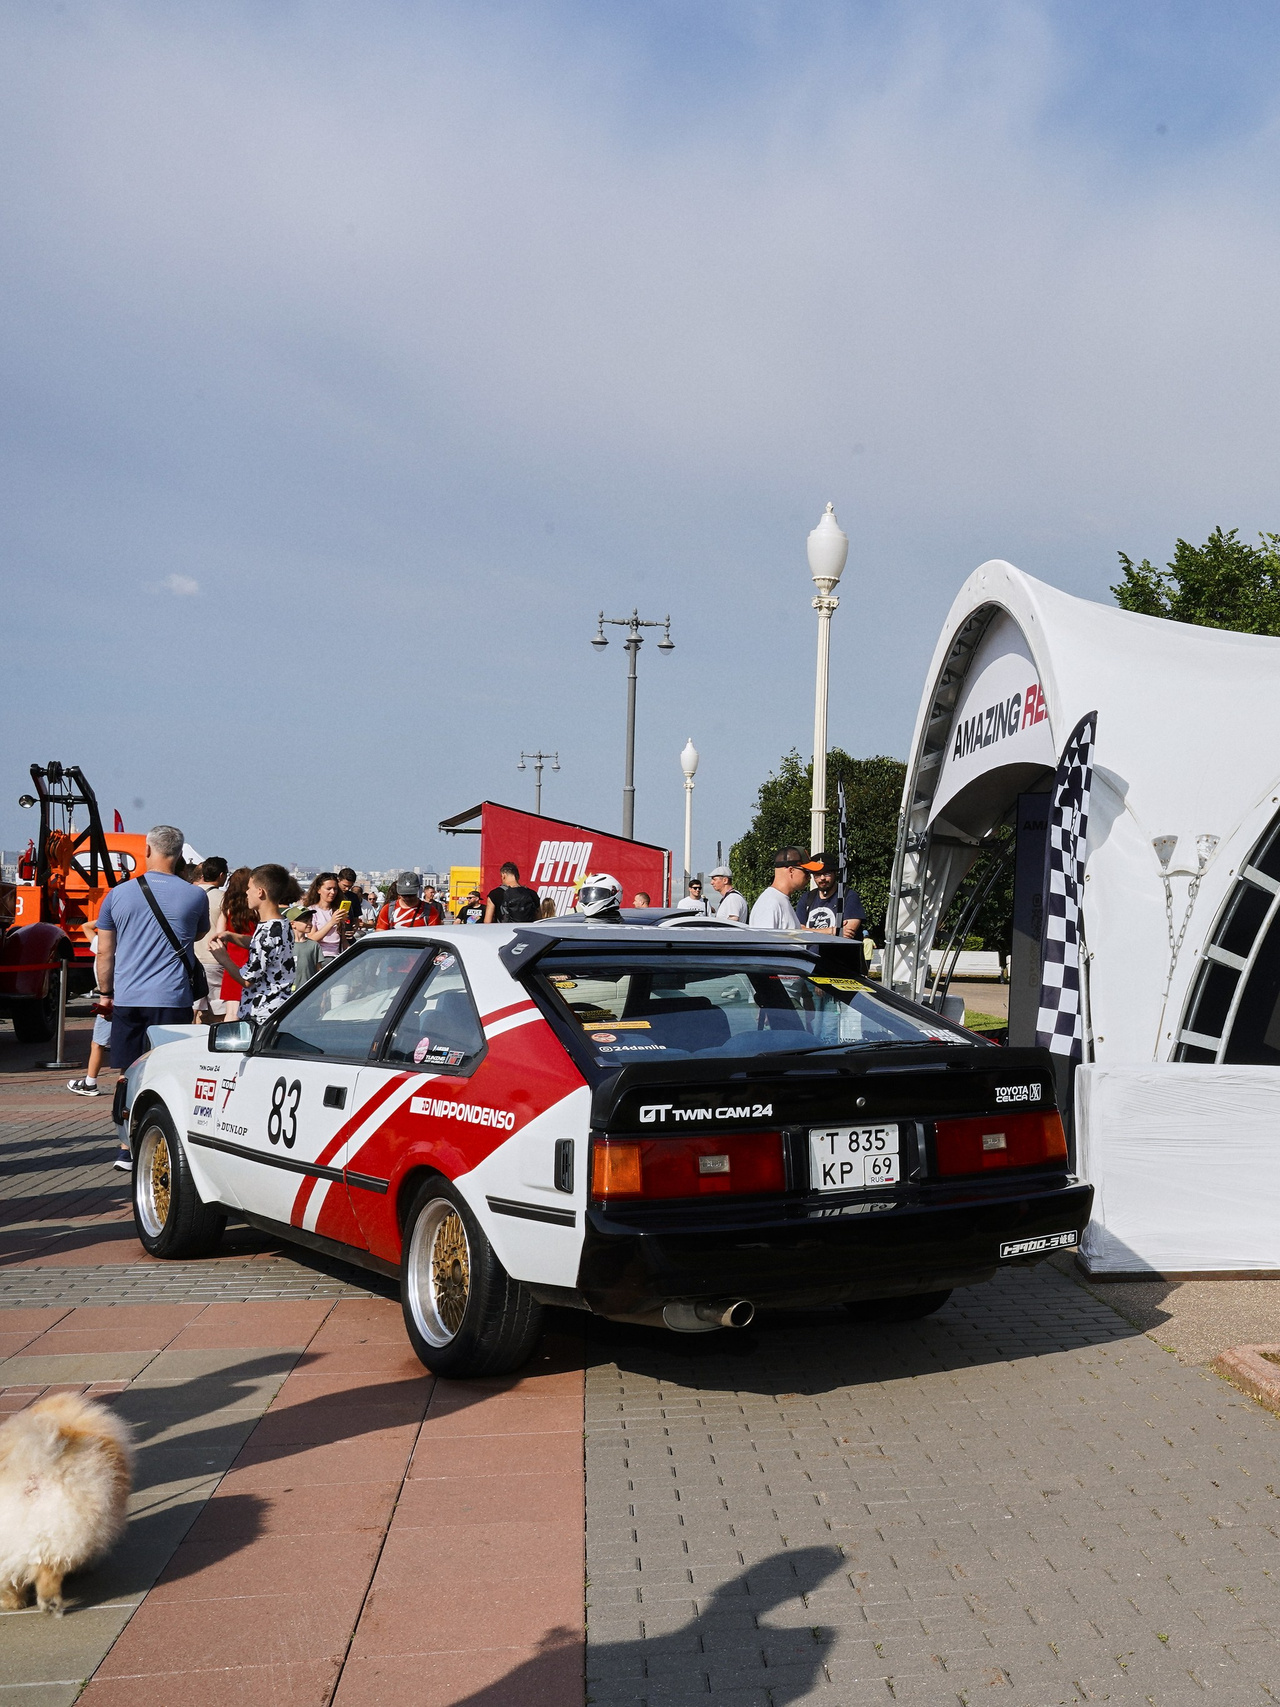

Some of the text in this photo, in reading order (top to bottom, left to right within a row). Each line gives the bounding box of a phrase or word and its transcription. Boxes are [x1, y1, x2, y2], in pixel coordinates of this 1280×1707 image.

[952, 682, 1050, 762] AMAZING RE
[995, 1086, 1028, 1097] TOYOTA
[996, 1095, 1028, 1103] CELICA
[268, 1076, 302, 1149] 83
[430, 1098, 515, 1131] NIPPONDENSO
[639, 1103, 773, 1123] GT TWIN CAM 24
[221, 1122, 248, 1136] DUNLOP
[825, 1129, 886, 1155] T 835
[872, 1158, 892, 1175] 69
